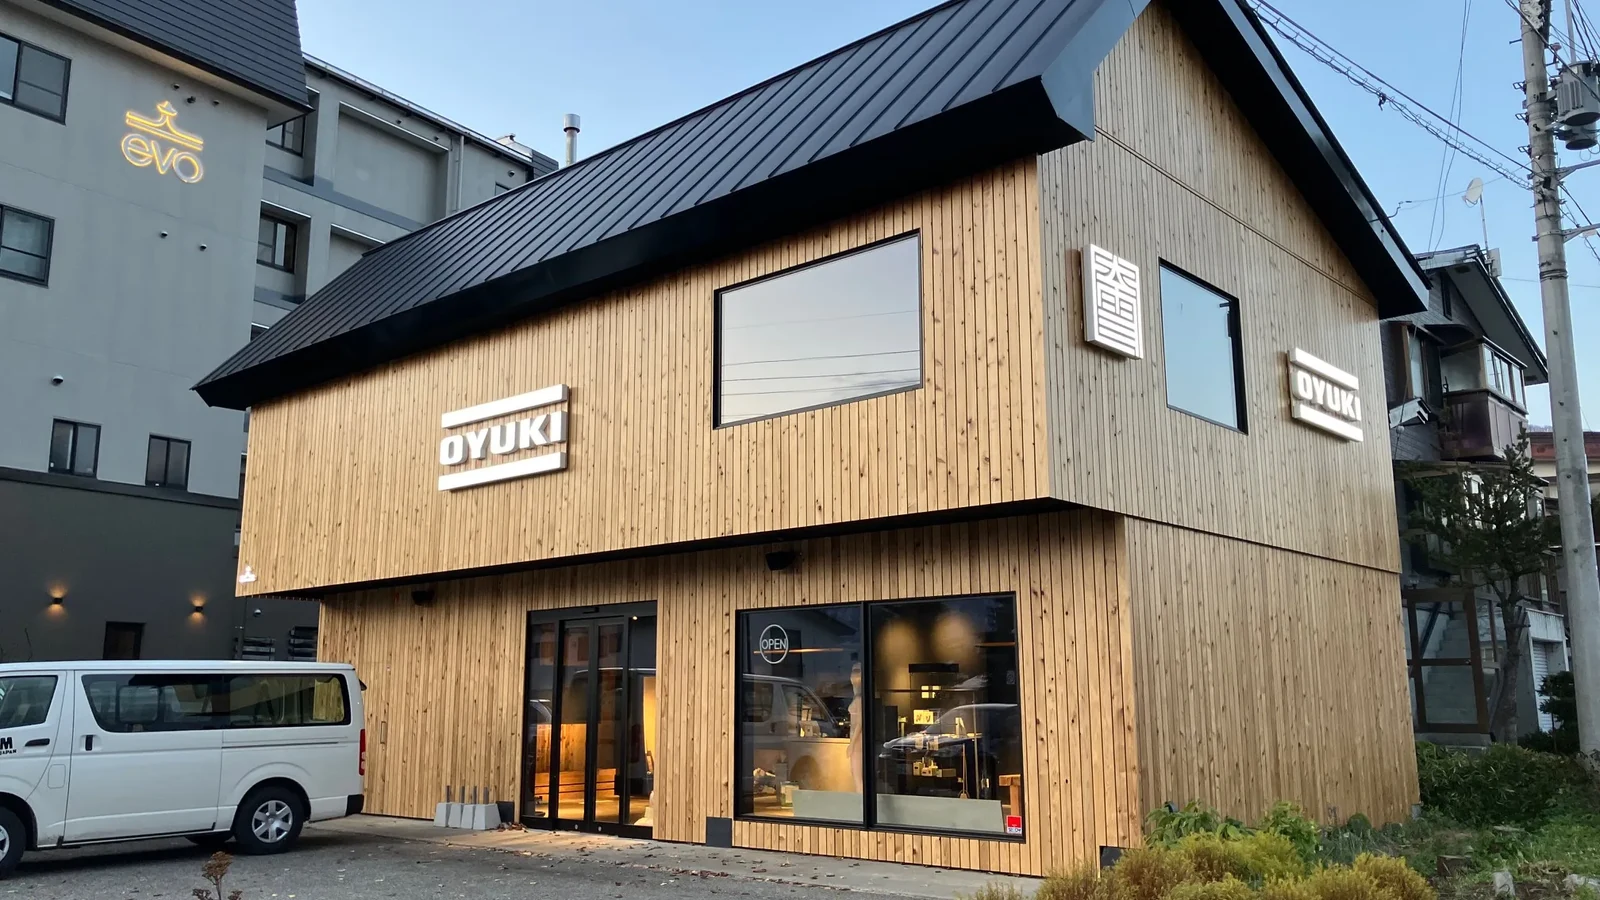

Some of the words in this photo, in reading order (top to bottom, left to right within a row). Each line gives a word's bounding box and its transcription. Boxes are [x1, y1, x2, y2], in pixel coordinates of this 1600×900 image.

[121, 133, 203, 183] evo
[1293, 369, 1361, 421] OYUKI
[440, 411, 566, 466] OYUKI
[761, 638, 787, 650] OPEN
